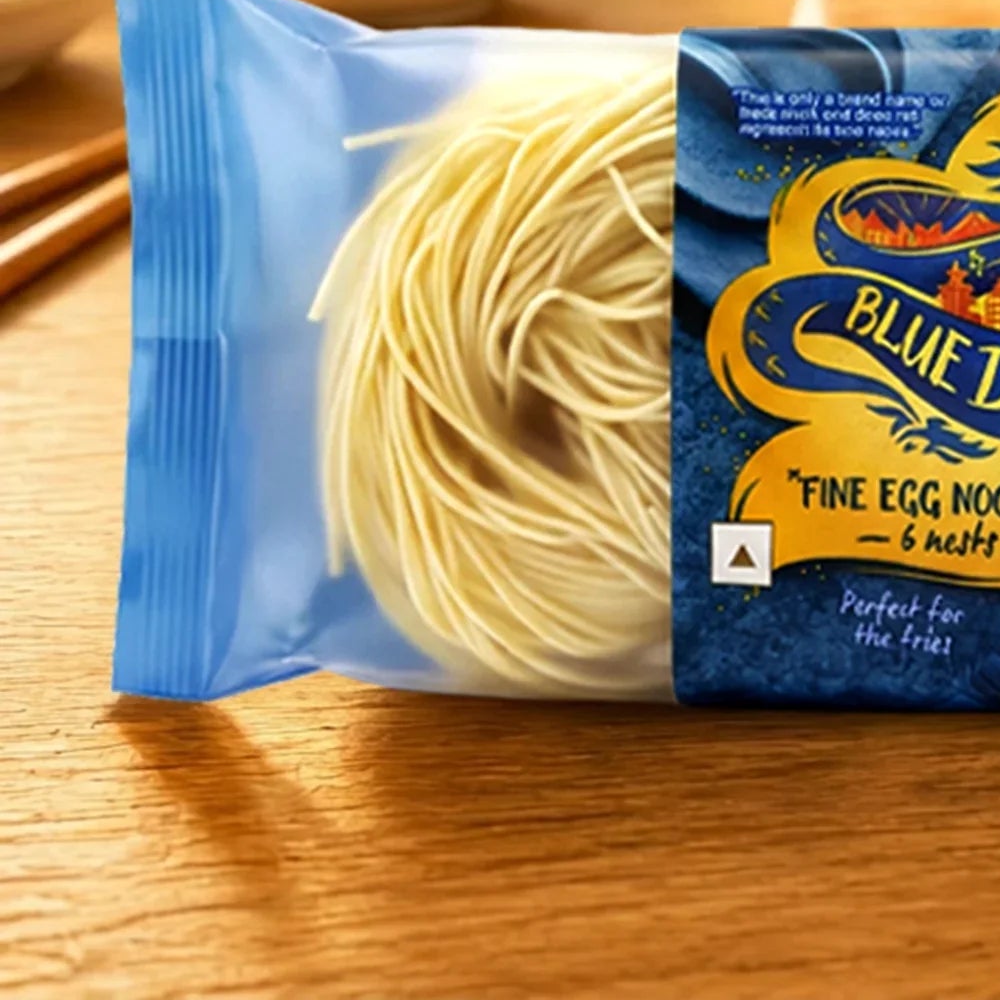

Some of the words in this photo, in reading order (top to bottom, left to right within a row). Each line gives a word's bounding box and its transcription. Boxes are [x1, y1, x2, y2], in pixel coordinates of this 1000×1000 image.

[844, 285, 973, 394] BLUE
[879, 478, 941, 519] EGG
[901, 524, 916, 551] 6
[924, 521, 999, 558] nests
[840, 589, 920, 626] Perfect
[928, 593, 965, 624] for
[855, 622, 893, 647] the
